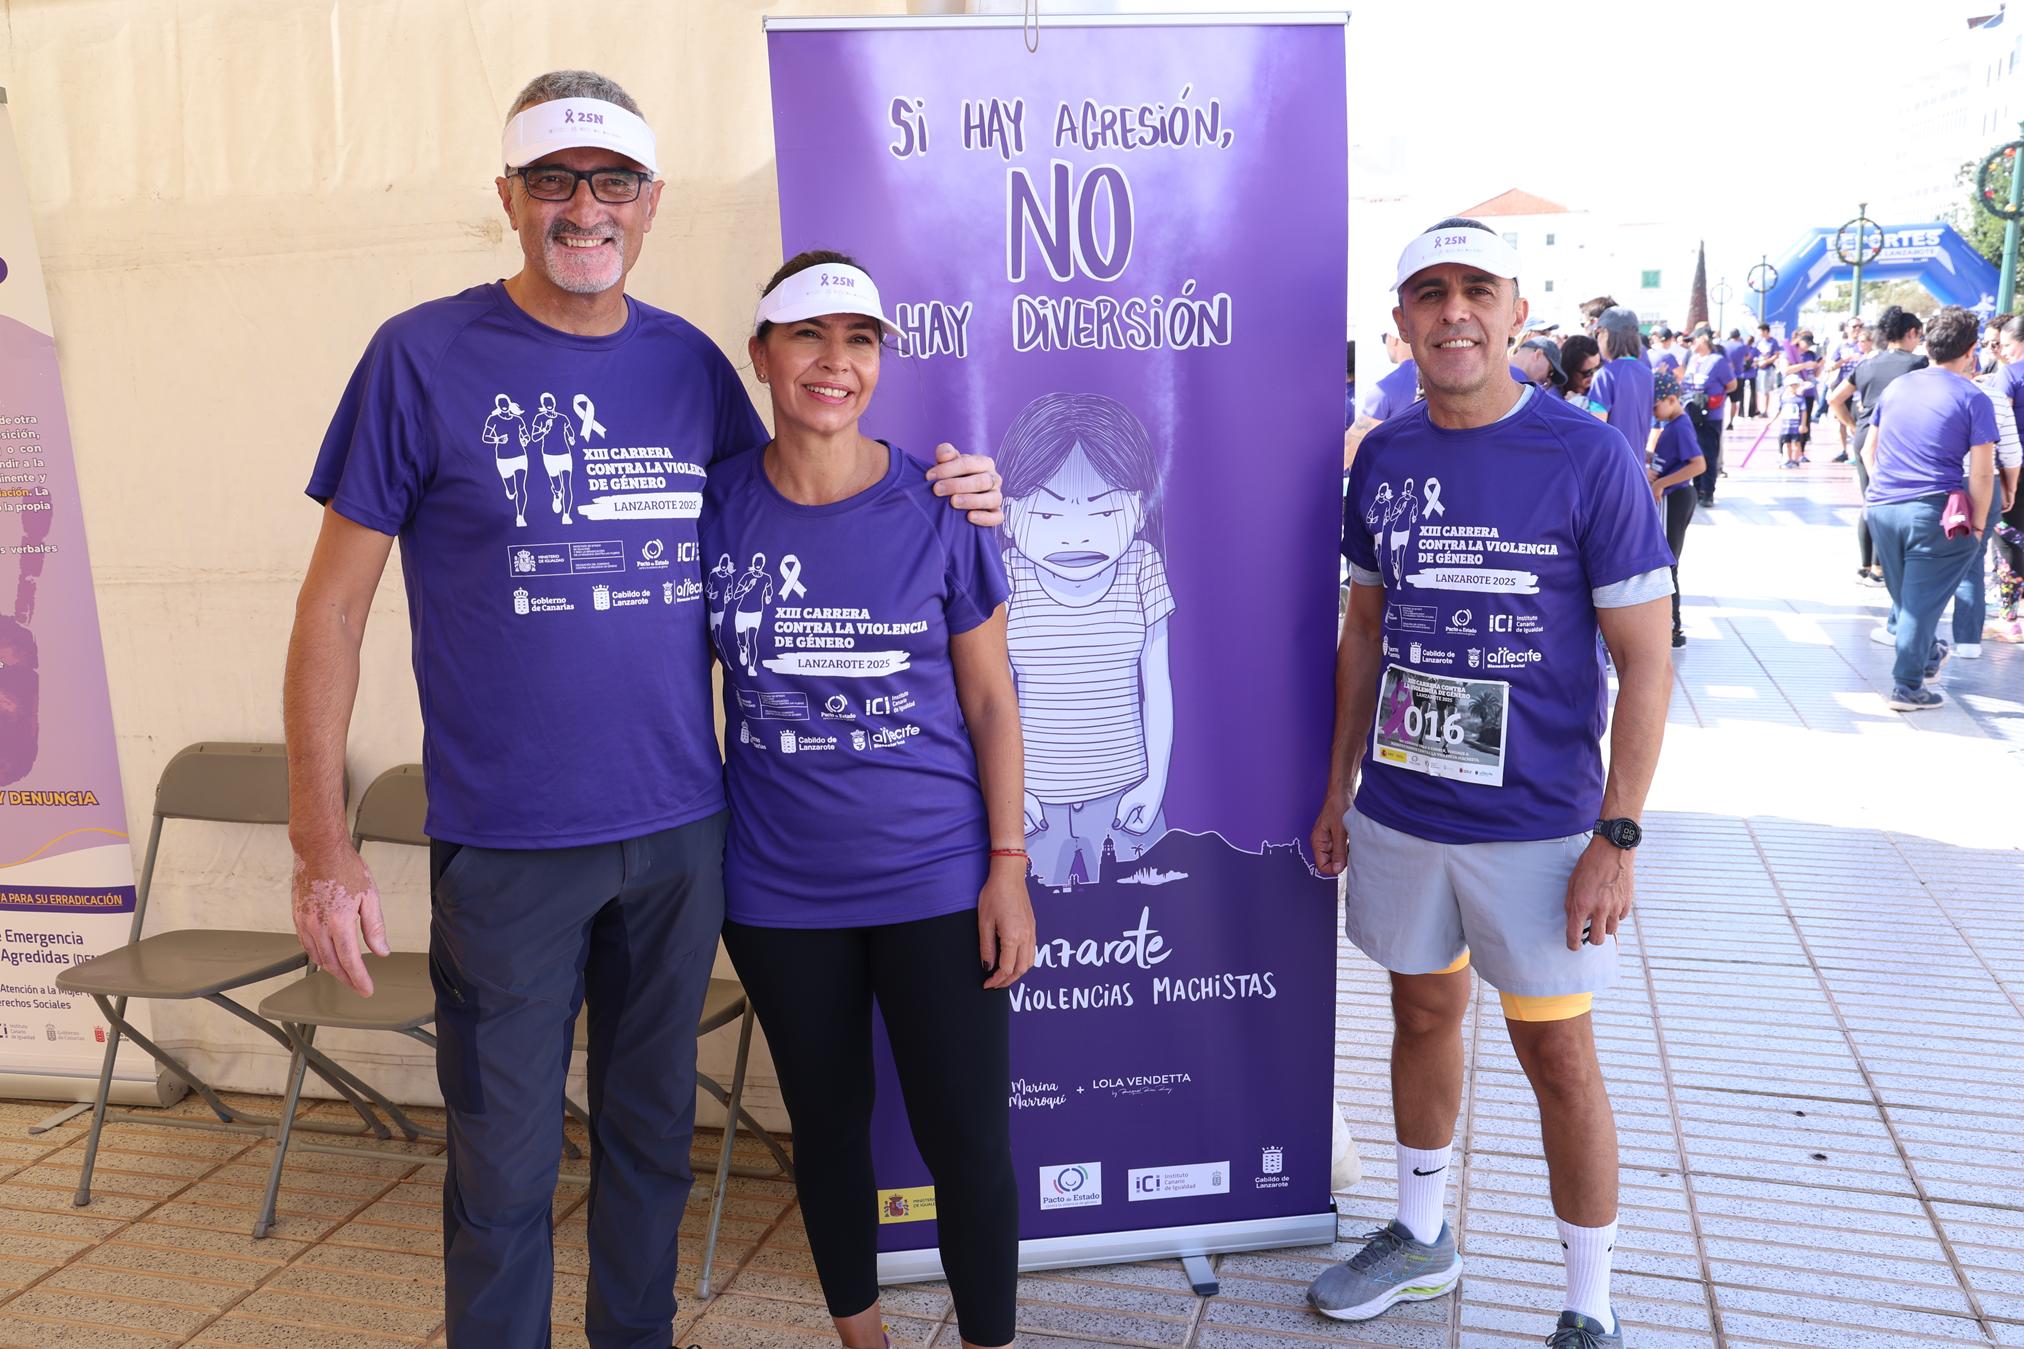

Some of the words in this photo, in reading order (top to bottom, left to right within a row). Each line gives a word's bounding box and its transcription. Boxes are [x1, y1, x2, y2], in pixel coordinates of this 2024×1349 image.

[578, 112, 604, 124] 25N
[961, 97, 1024, 161] HAY
[1006, 158, 1135, 283] NO
[1444, 236, 1467, 245] 25N
[832, 276, 855, 288] 25N
[896, 300, 973, 360] HAY
[14, 415, 38, 424] otra
[0, 428, 41, 440] sición,
[7, 446, 14, 454] o
[20, 445, 42, 453] con
[583, 448, 609, 460] XIII
[610, 447, 673, 459] CARRERA
[23, 460, 30, 468] a
[32, 457, 45, 467] la
[586, 462, 645, 475] CONTRA
[645, 462, 664, 474] LA
[0, 473, 35, 482] inente
[39, 474, 46, 483] y
[588, 478, 608, 491] DE
[610, 475, 666, 489] GÉNERO
[35, 487, 49, 496] La
[4, 502, 14, 511] la
[16, 500, 51, 513] propia
[614, 501, 677, 511] LANZAROTE
[679, 500, 697, 510] 2025
[1419, 526, 1441, 536] XIII
[1442, 526, 1499, 538] CARRERA
[10, 544, 58, 555] verbales
[1418, 539, 1467, 551] CONTRA
[1468, 540, 1484, 551] LA
[1485, 540, 1559, 555] VIOLENCIA
[1418, 553, 1434, 563] DE
[1435, 550, 1484, 565] GÉNERO
[1435, 573, 1491, 585] LANZAROTE
[1493, 577, 1516, 586] 2025
[612, 590, 640, 599] Cabildo
[641, 589, 651, 597] de
[530, 597, 566, 605] Gobierno
[541, 603, 575, 611] Canarias
[612, 598, 649, 607] Lanzarote
[775, 607, 801, 619] XIII
[803, 607, 871, 620] CARRERA
[774, 621, 834, 634] CONTRA
[835, 622, 855, 634] LA
[856, 620, 928, 635] VIOLENCIA
[1523, 626, 1544, 634] Igualdad
[774, 636, 794, 648] DE
[795, 634, 855, 649] GÉNERO
[1422, 649, 1446, 658] Cabildo
[798, 658, 865, 669] LANZAROTE
[866, 659, 890, 669] 2025
[1441, 684, 1466, 693] CONTRA
[1446, 690, 1471, 699] GÉNERO
[1403, 706, 1465, 745] 016
[798, 736, 826, 744] Cabildo
[8, 790, 100, 806] DENUNCIA
[9, 893, 34, 904] PARA
[35, 894, 48, 904] SU
[50, 892, 122, 906] ERRADICACIÓN
[5, 929, 84, 948] Emergencia
[1033, 905, 1173, 969] nzarote
[1, 948, 70, 966] Agredidas
[0, 984, 39, 994] Atención
[47, 985, 57, 995] la
[0, 999, 32, 1008] rechos
[33, 999, 72, 1010] Sociales
[1011, 1078, 1059, 1095] Marina
[1093, 1079, 1124, 1089] LOLA
[1127, 1073, 1191, 1086] VENDETTA
[1172, 1183, 1196, 1192] Igualdad
[1043, 1196, 1065, 1204] Pacto
[1073, 1192, 1100, 1201] Estado
